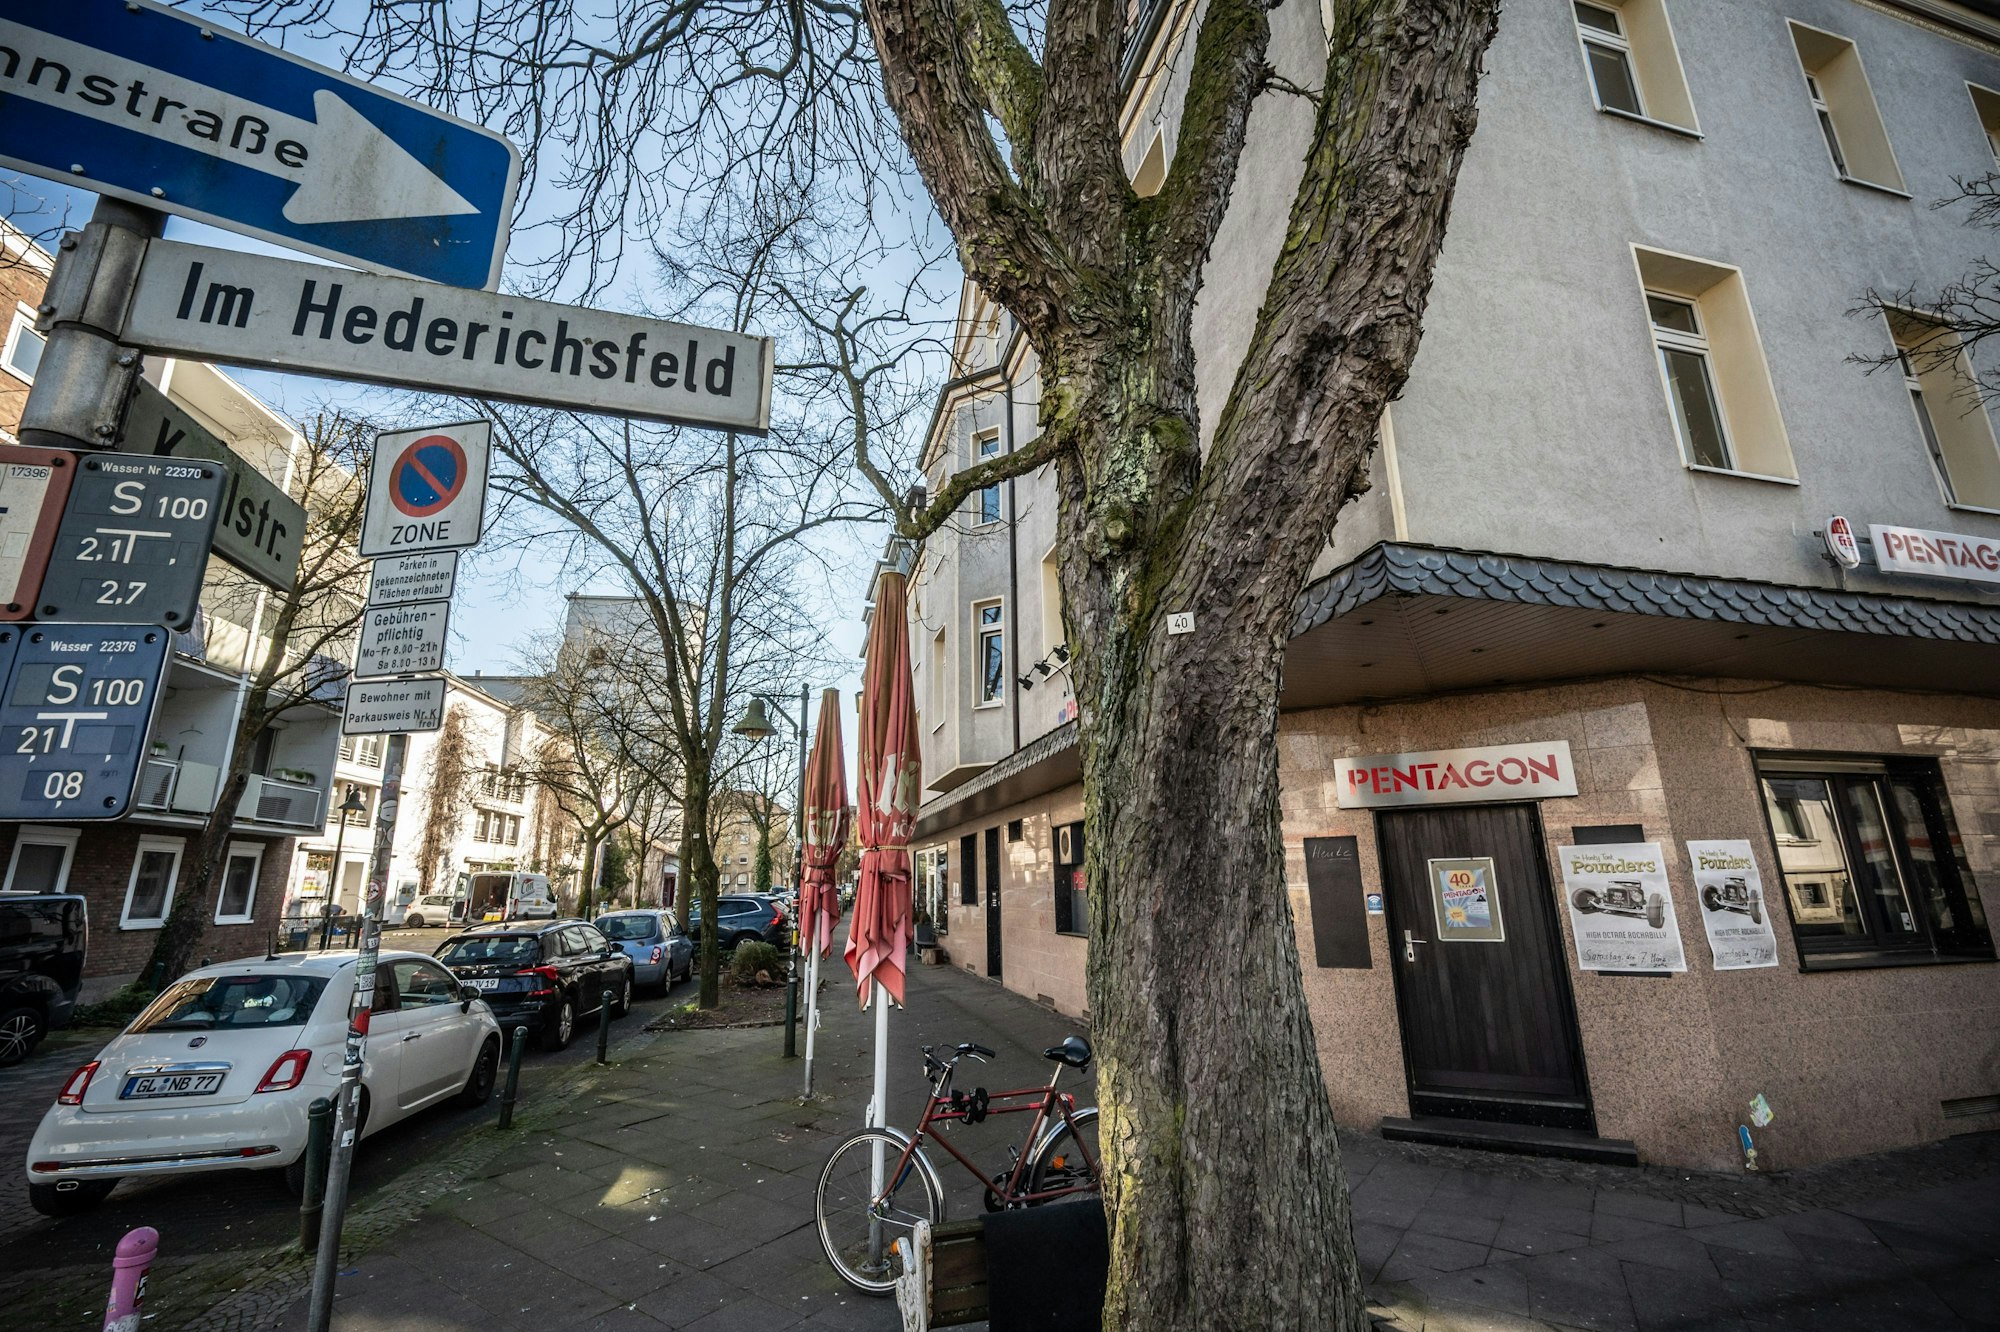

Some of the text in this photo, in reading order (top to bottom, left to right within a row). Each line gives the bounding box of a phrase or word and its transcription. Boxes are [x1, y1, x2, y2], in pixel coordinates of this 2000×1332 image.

[176, 261, 735, 397] Im Hederichsfeld
[11, 466, 47, 478] 17396
[101, 462, 201, 479] Wasser Nr 22370
[109, 481, 208, 520] S 100
[390, 520, 451, 545] ZONE
[1882, 532, 2000, 572] PENTAG
[399, 558, 438, 571] Parken in
[375, 571, 450, 589] gekennzeichneten
[378, 583, 444, 600] Flächen erlaubt
[1174, 617, 1188, 629] 40
[376, 626, 424, 645] pflichtig
[51, 641, 137, 653] Wasser 22376
[377, 661, 389, 670] Sa
[46, 665, 144, 706] S 100
[360, 690, 432, 703] Bewohner mit
[348, 708, 437, 723] Parkausweis Nr. K
[419, 719, 436, 728] frei
[1347, 753, 1560, 795] PENTAGON
[1571, 858, 1657, 874] Pounders
[1698, 855, 1752, 870] Pounders
[1449, 872, 1471, 887] 40
[1443, 887, 1485, 899] PENTAGON
[485, 979, 496, 988] 19
[136, 1075, 217, 1093] GL NB 77
